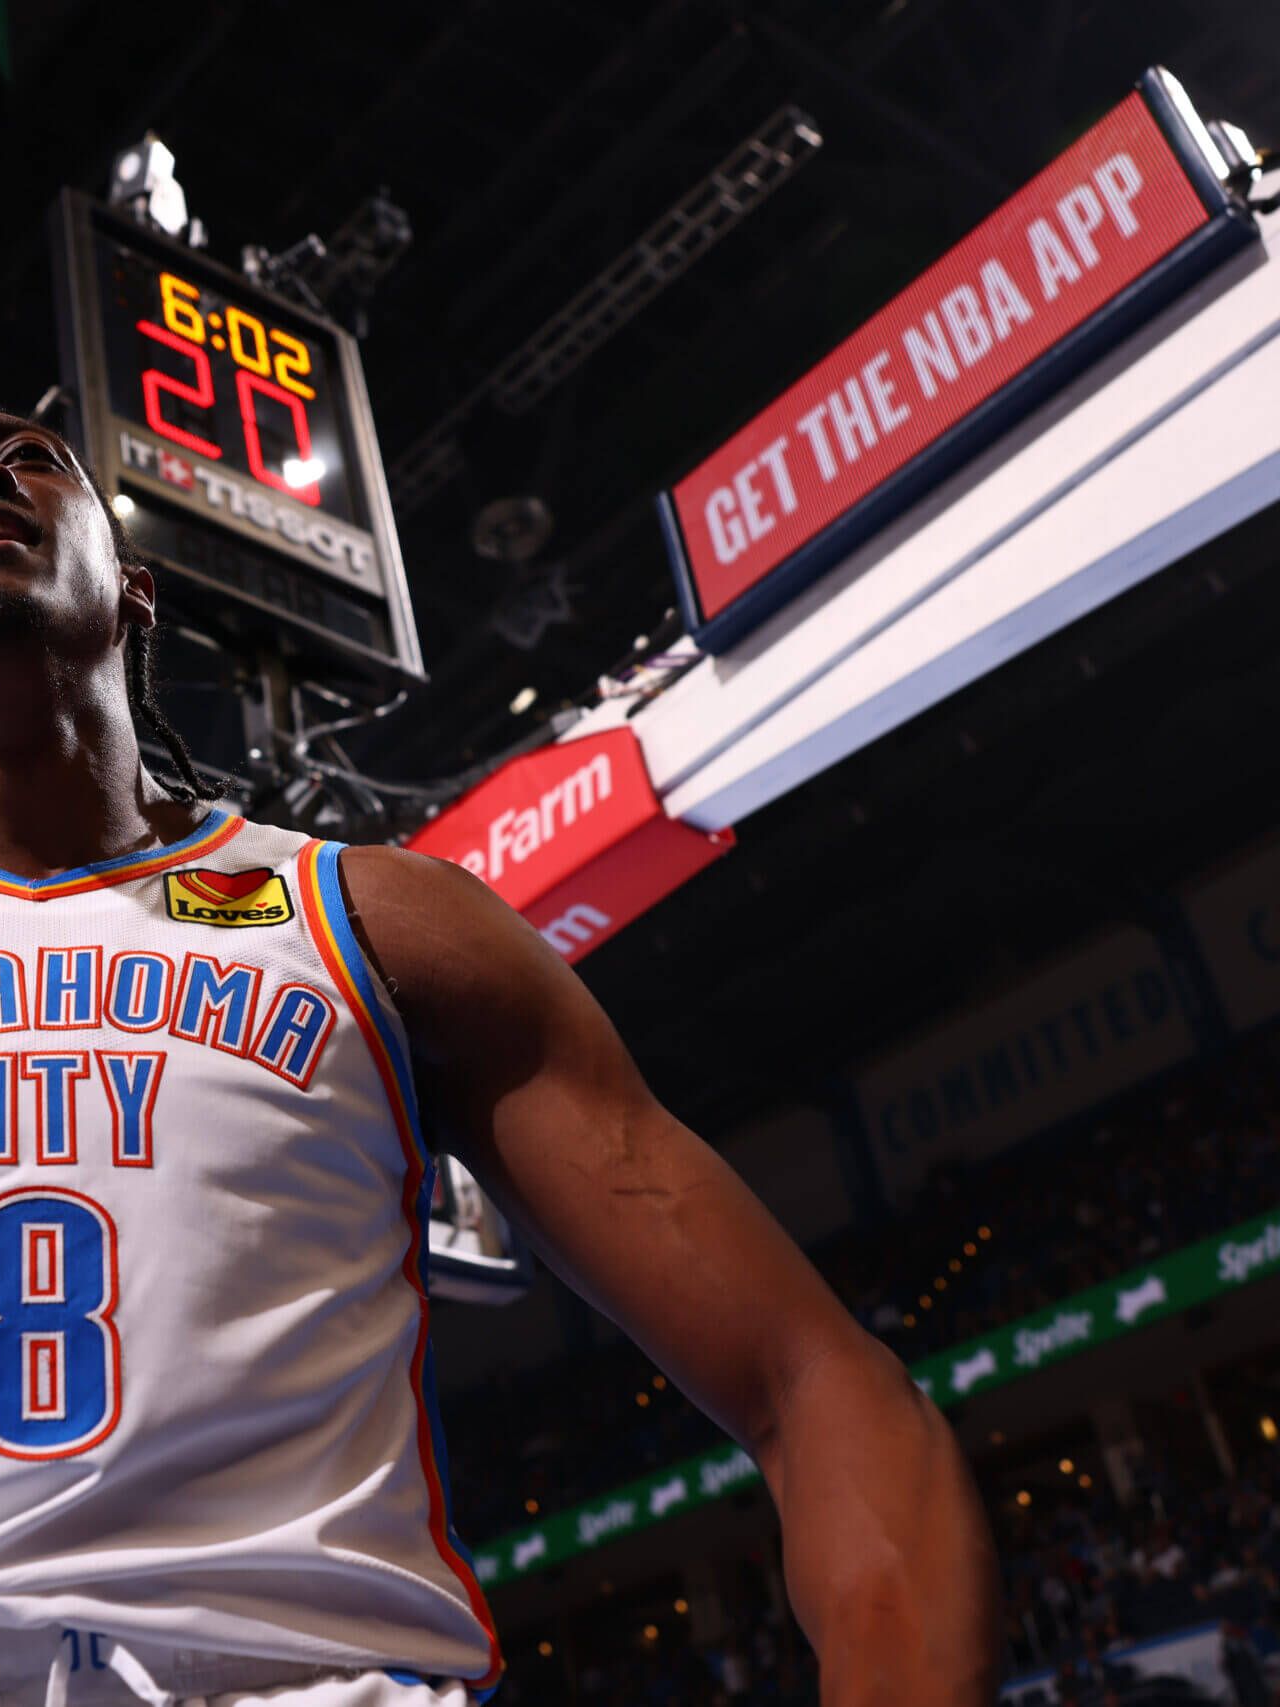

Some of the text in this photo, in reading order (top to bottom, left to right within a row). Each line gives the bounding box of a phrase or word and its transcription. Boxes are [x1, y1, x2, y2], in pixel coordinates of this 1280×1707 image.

[136, 319, 322, 507] 20
[159, 271, 316, 400] 6:02
[703, 153, 1144, 566] GET THE NBA APP
[194, 464, 374, 576] TISSOT
[447, 752, 613, 882] eFarm
[879, 966, 1170, 1155] COMMITTED
